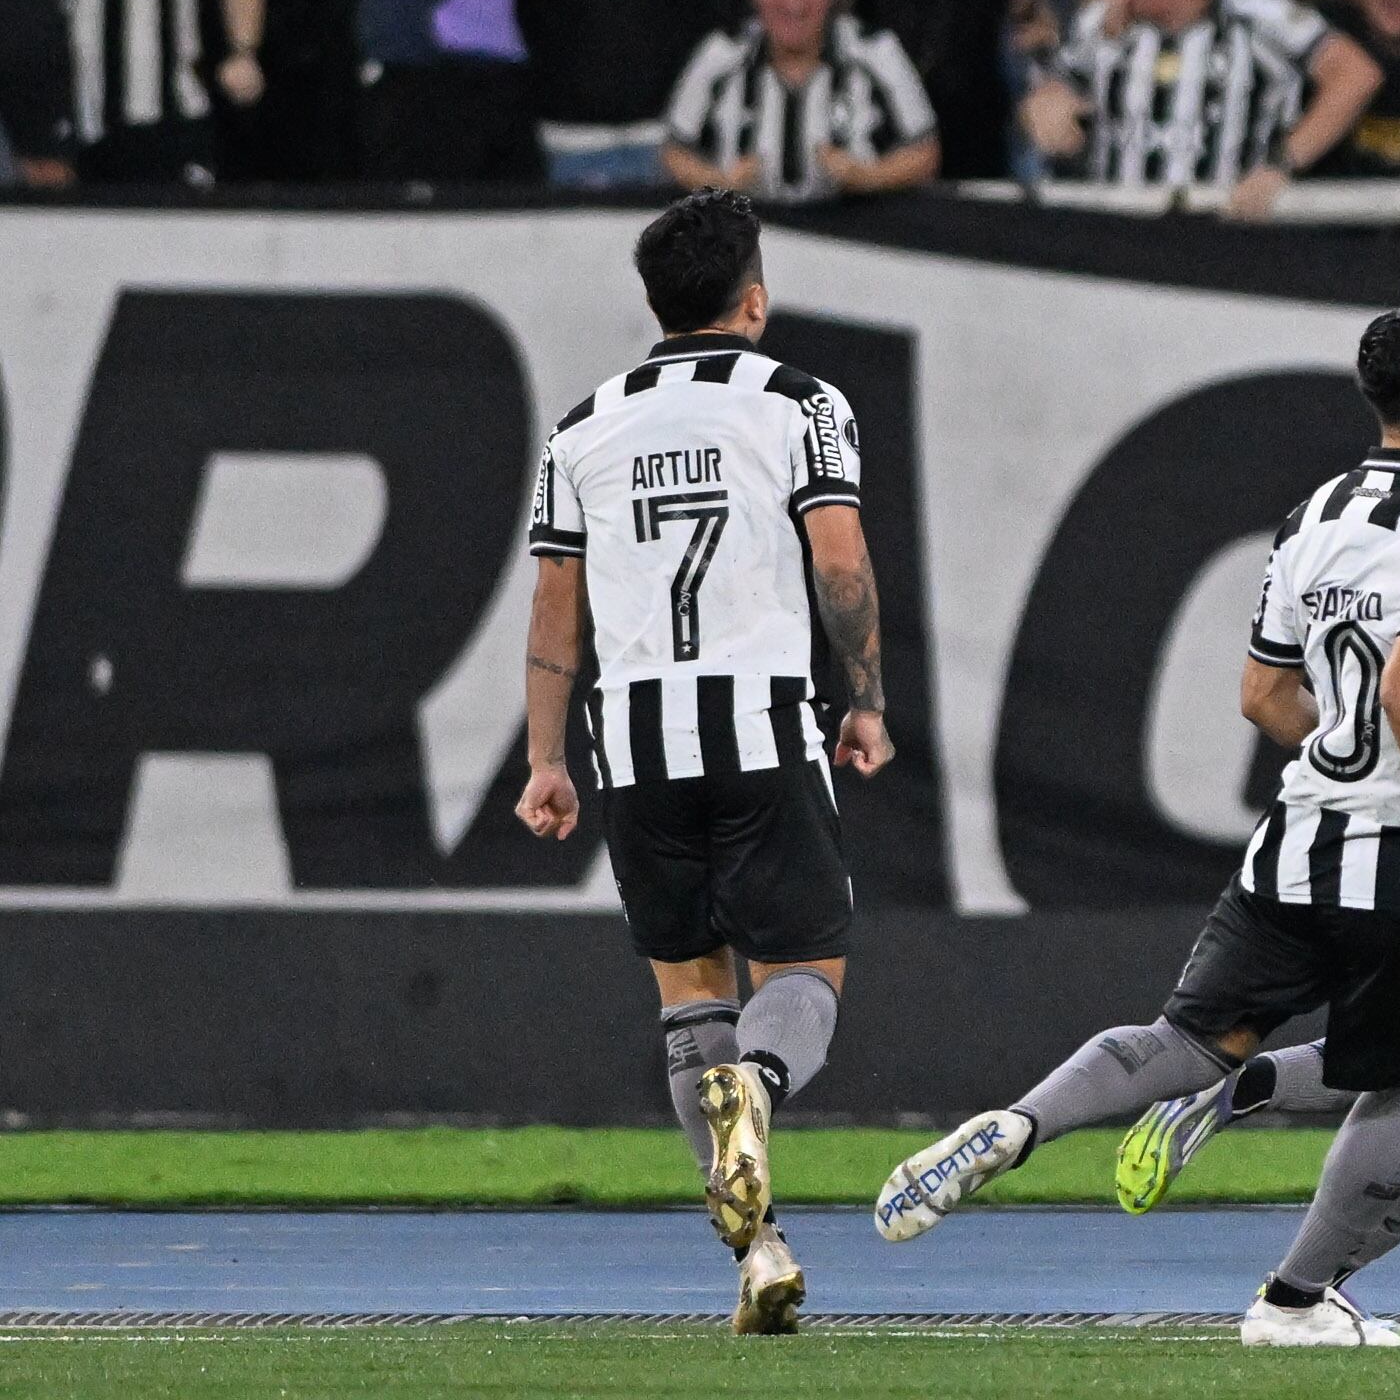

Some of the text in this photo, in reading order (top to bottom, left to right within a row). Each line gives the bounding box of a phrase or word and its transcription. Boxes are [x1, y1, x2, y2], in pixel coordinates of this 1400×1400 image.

[632, 448, 722, 491] ARTUR
[811, 393, 845, 479] Centrum
[632, 489, 730, 663] 7
[877, 1120, 1006, 1228] PREDATOR
